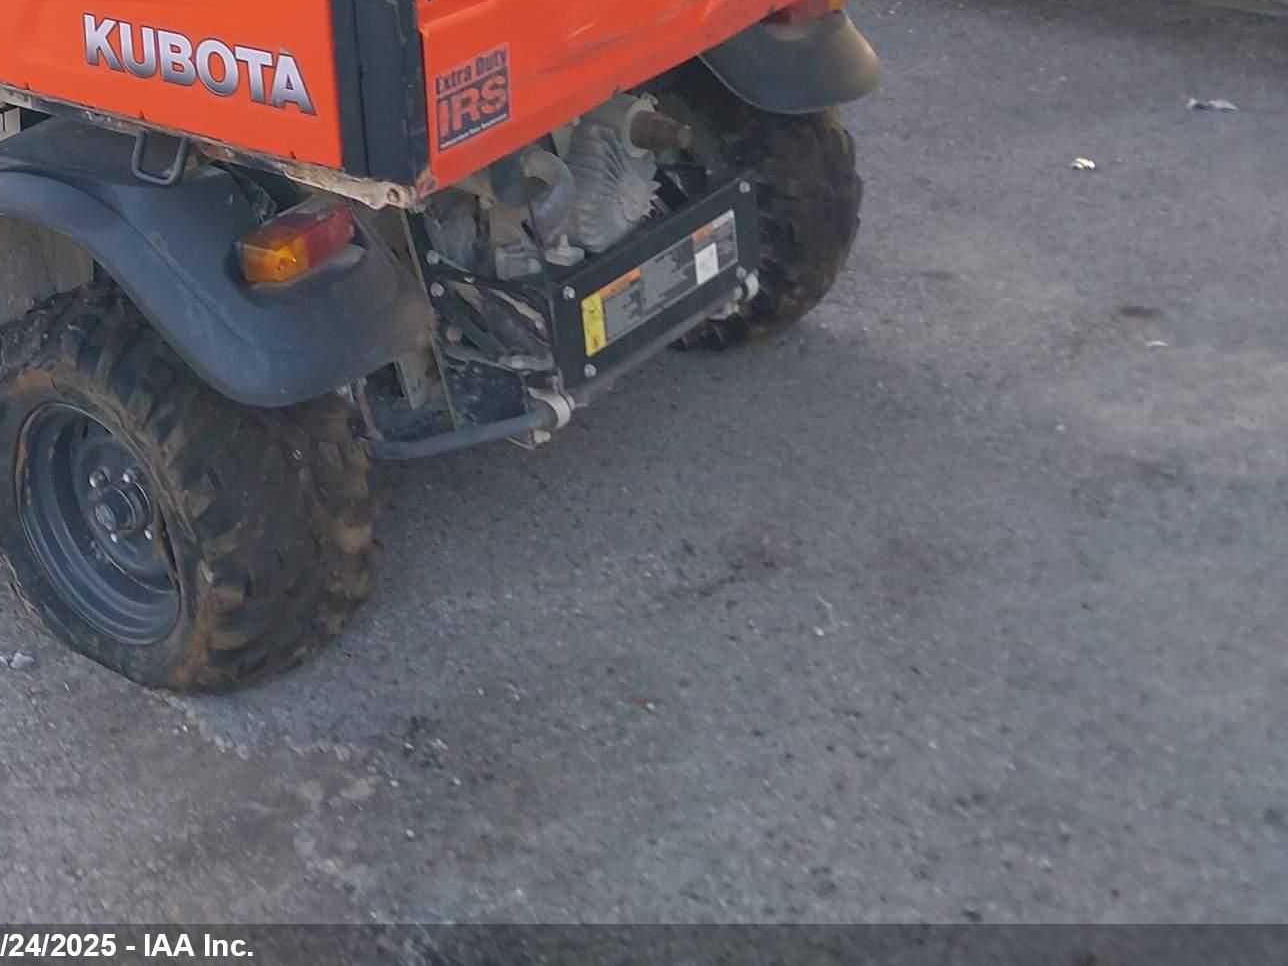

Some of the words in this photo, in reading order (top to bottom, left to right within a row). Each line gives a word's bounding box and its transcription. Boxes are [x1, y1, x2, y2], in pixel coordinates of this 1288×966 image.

[81, 11, 317, 116] KUBOTA
[435, 66, 472, 95] Extra
[476, 49, 507, 75] Duty
[438, 75, 507, 139] IRS
